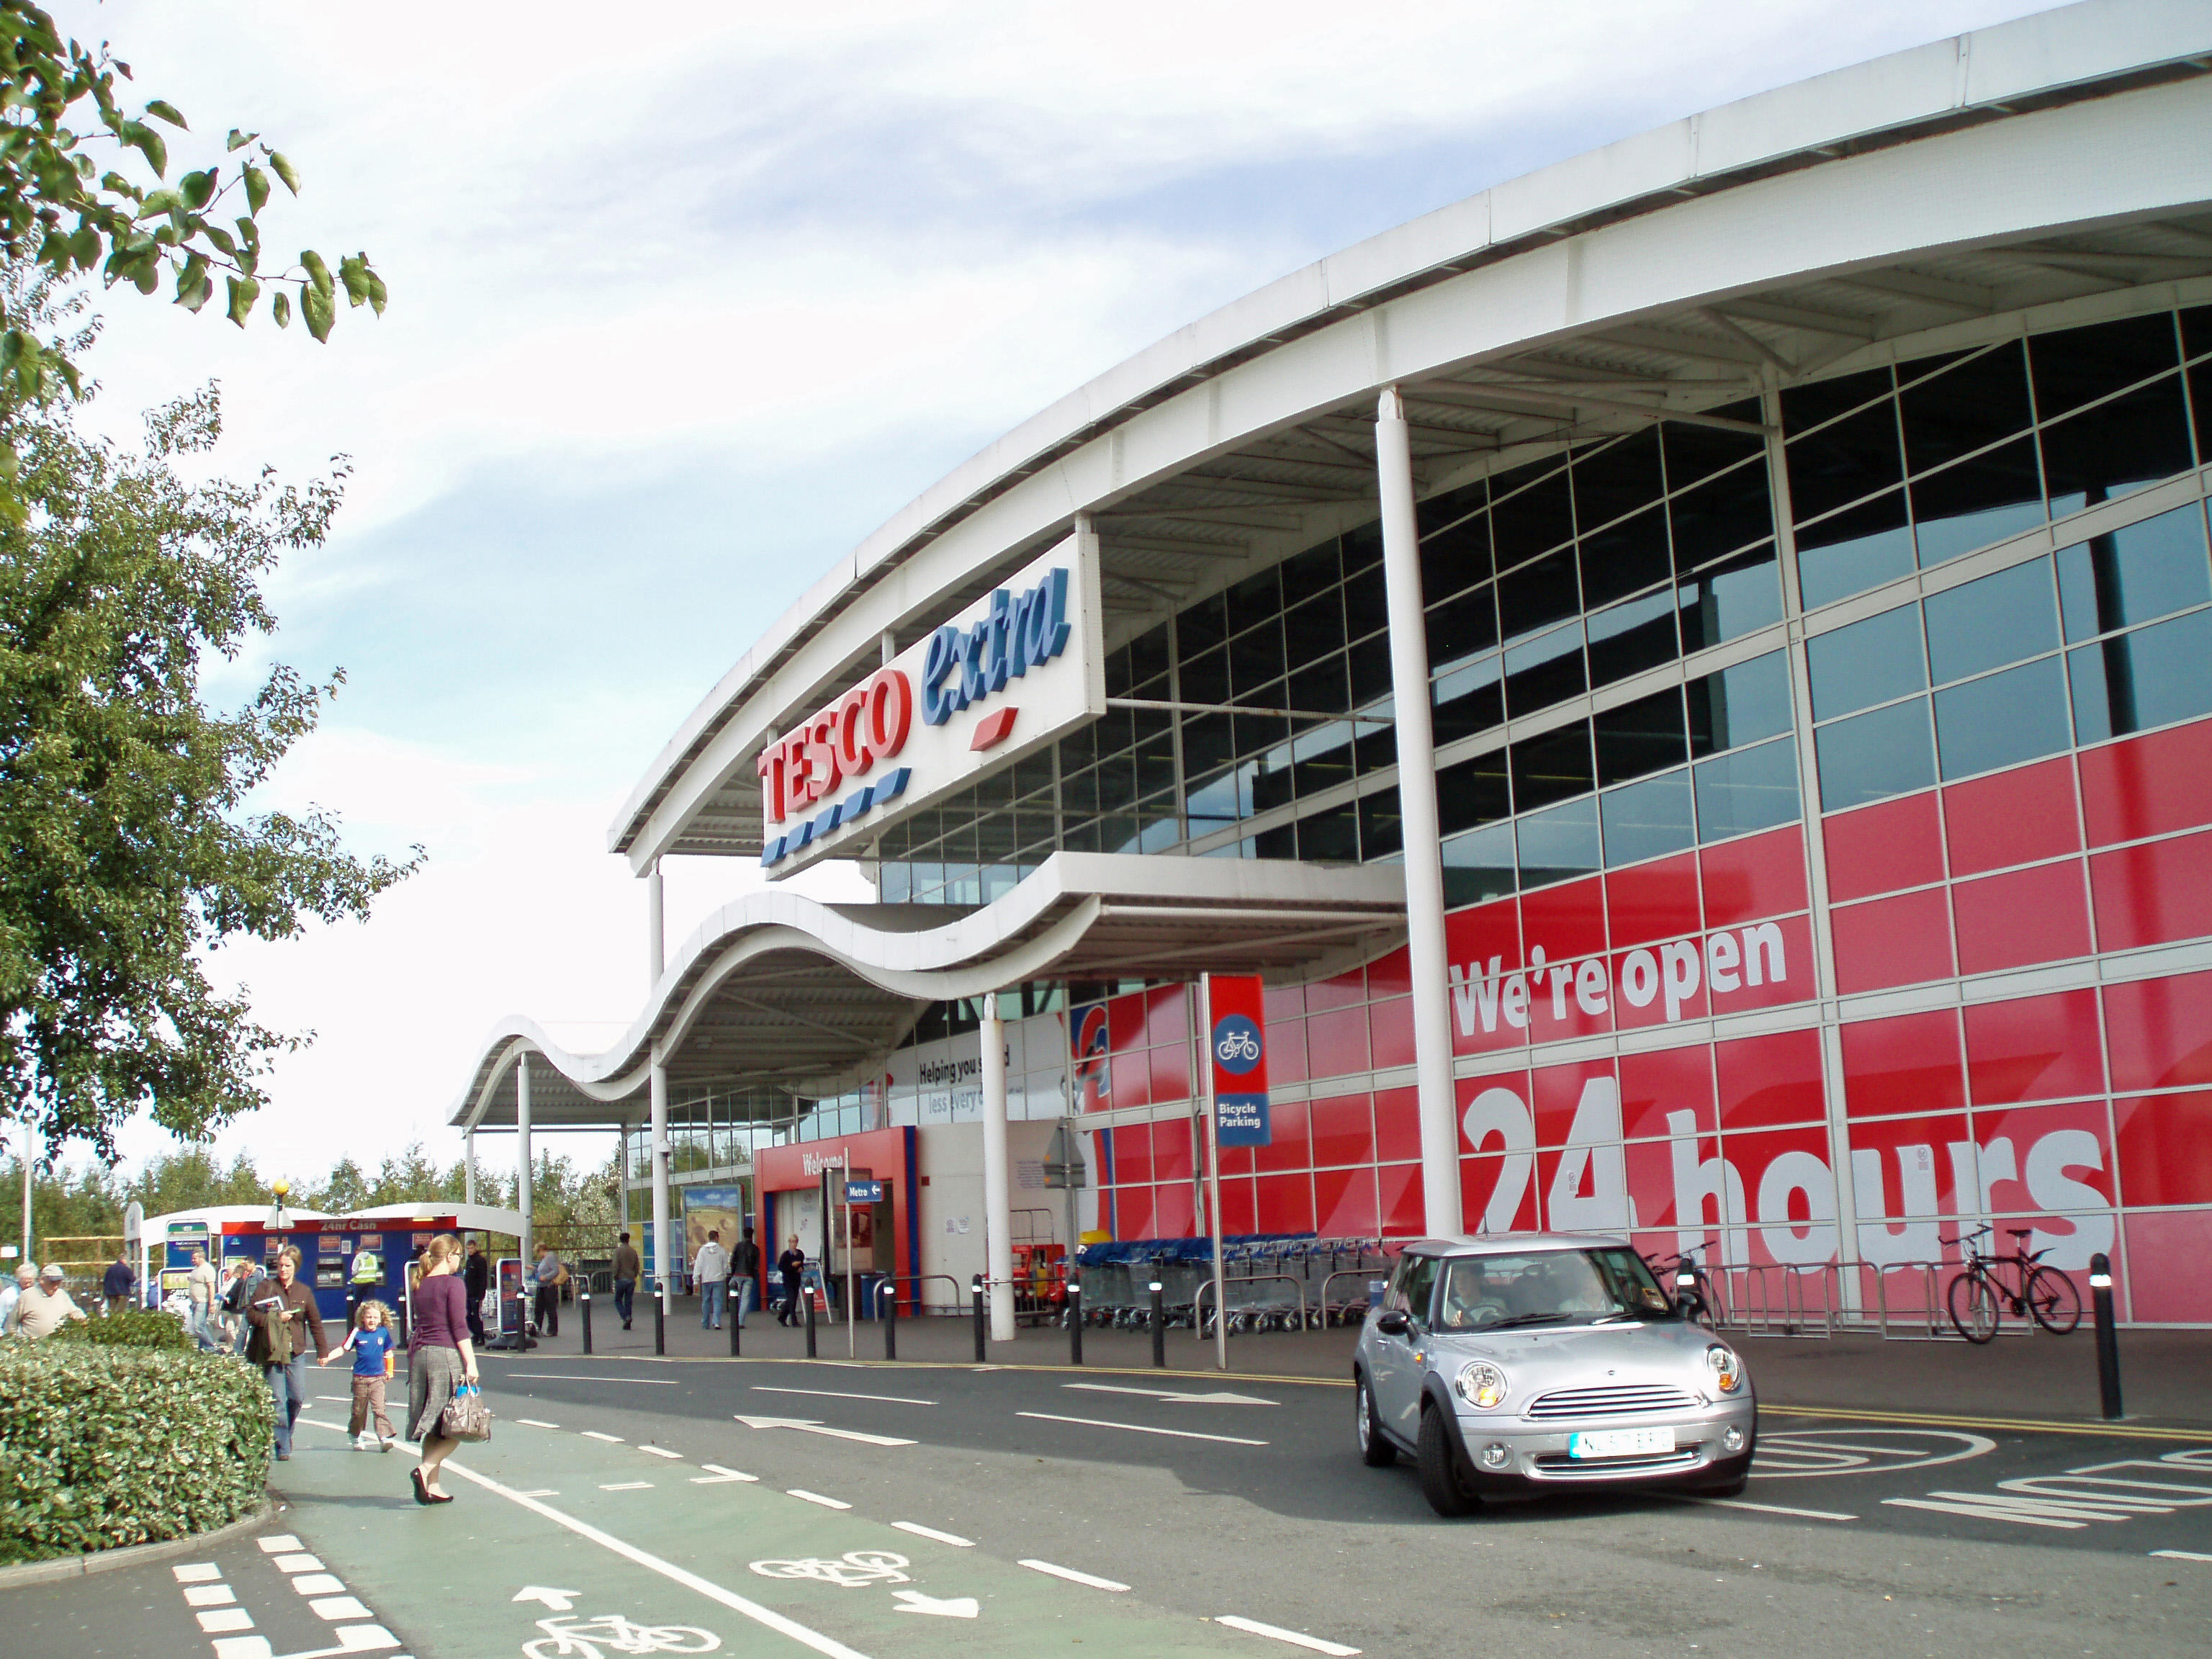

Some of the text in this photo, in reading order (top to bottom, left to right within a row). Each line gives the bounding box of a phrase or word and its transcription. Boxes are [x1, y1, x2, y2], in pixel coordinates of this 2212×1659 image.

[758, 567, 1071, 824] TESCO extra
[1449, 922, 1787, 1037] We're open
[919, 1058, 976, 1086] Helping you
[1219, 1102, 1256, 1116] Bicycle
[1220, 1116, 1261, 1129] Parking
[803, 1152, 843, 1176] Welcome
[1462, 1075, 2118, 1276] 24 hours
[850, 1187, 868, 1197] Metro
[320, 1220, 377, 1231] 24hr Cash
